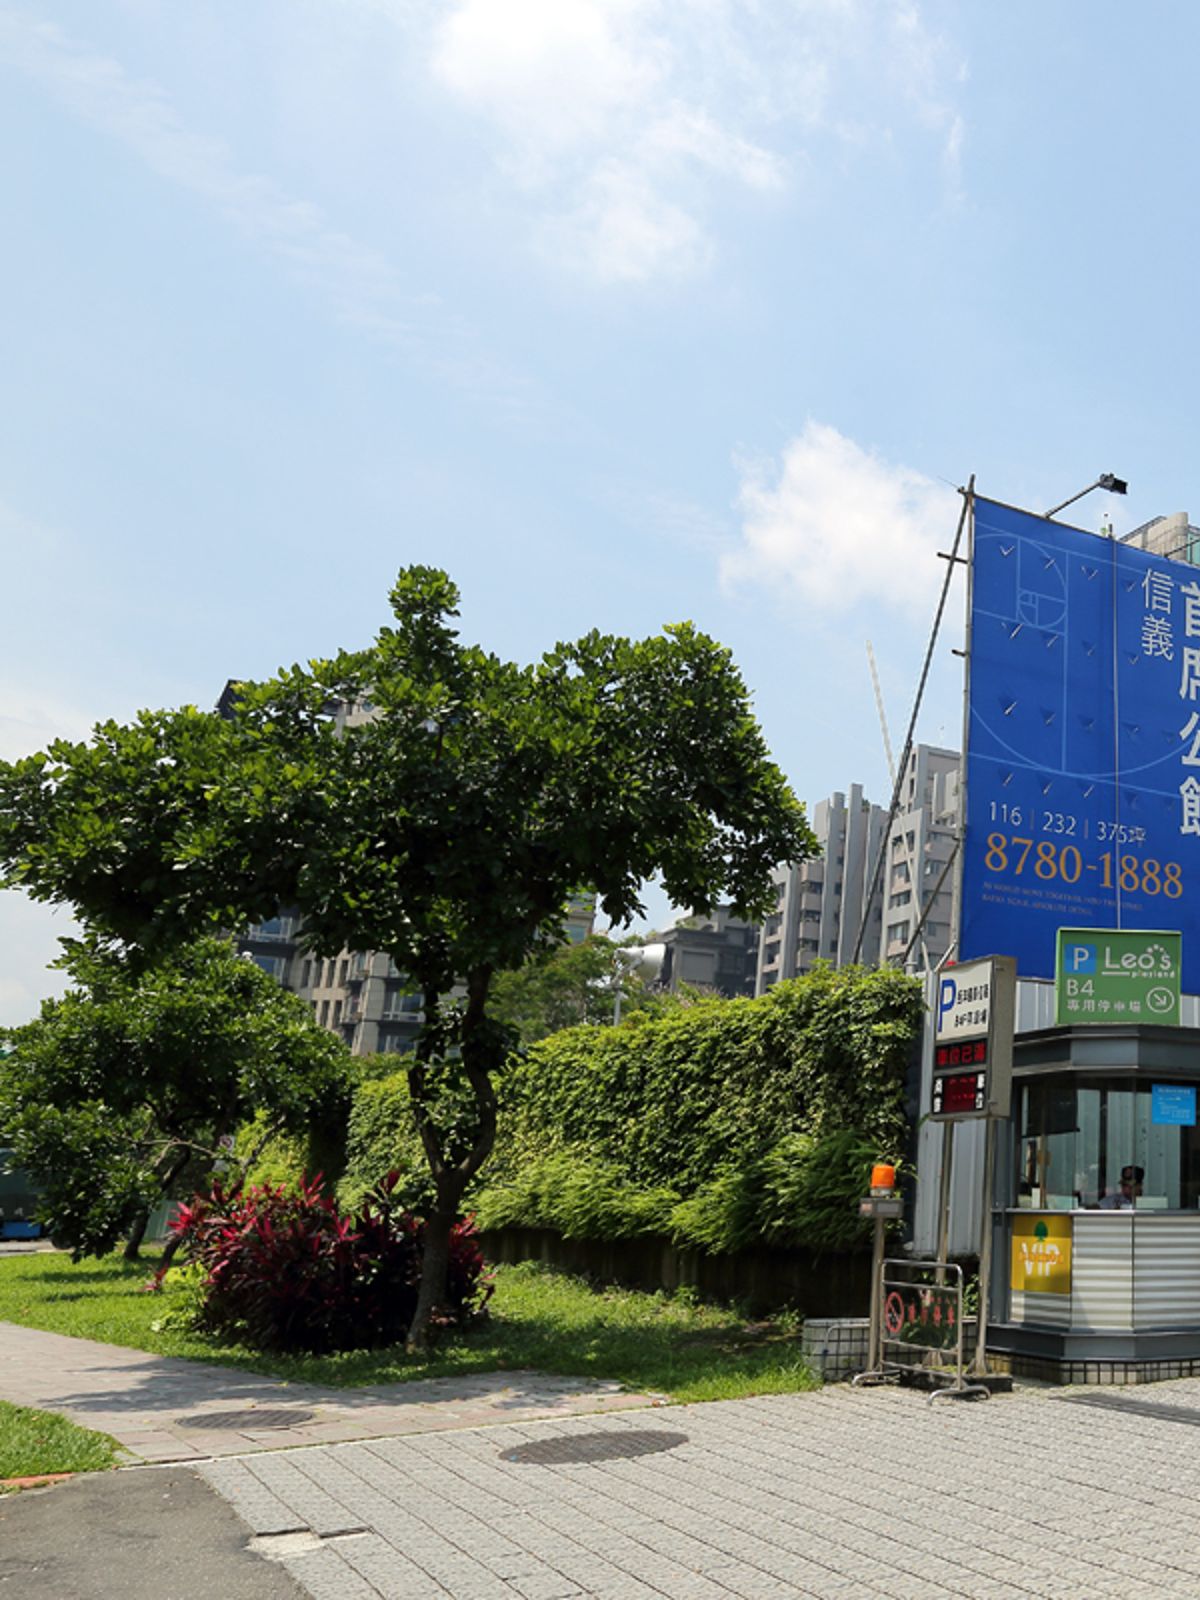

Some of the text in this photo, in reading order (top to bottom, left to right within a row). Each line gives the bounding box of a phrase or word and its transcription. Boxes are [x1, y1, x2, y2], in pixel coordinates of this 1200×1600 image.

[1141, 567, 1175, 661] 信義
[989, 801, 1023, 826] 116
[1042, 811, 1077, 836] 232
[984, 832, 1183, 899] 8780-1888
[1073, 944, 1172, 971] P Leo's
[937, 979, 957, 1033] P
[1066, 979, 1095, 997] B4
